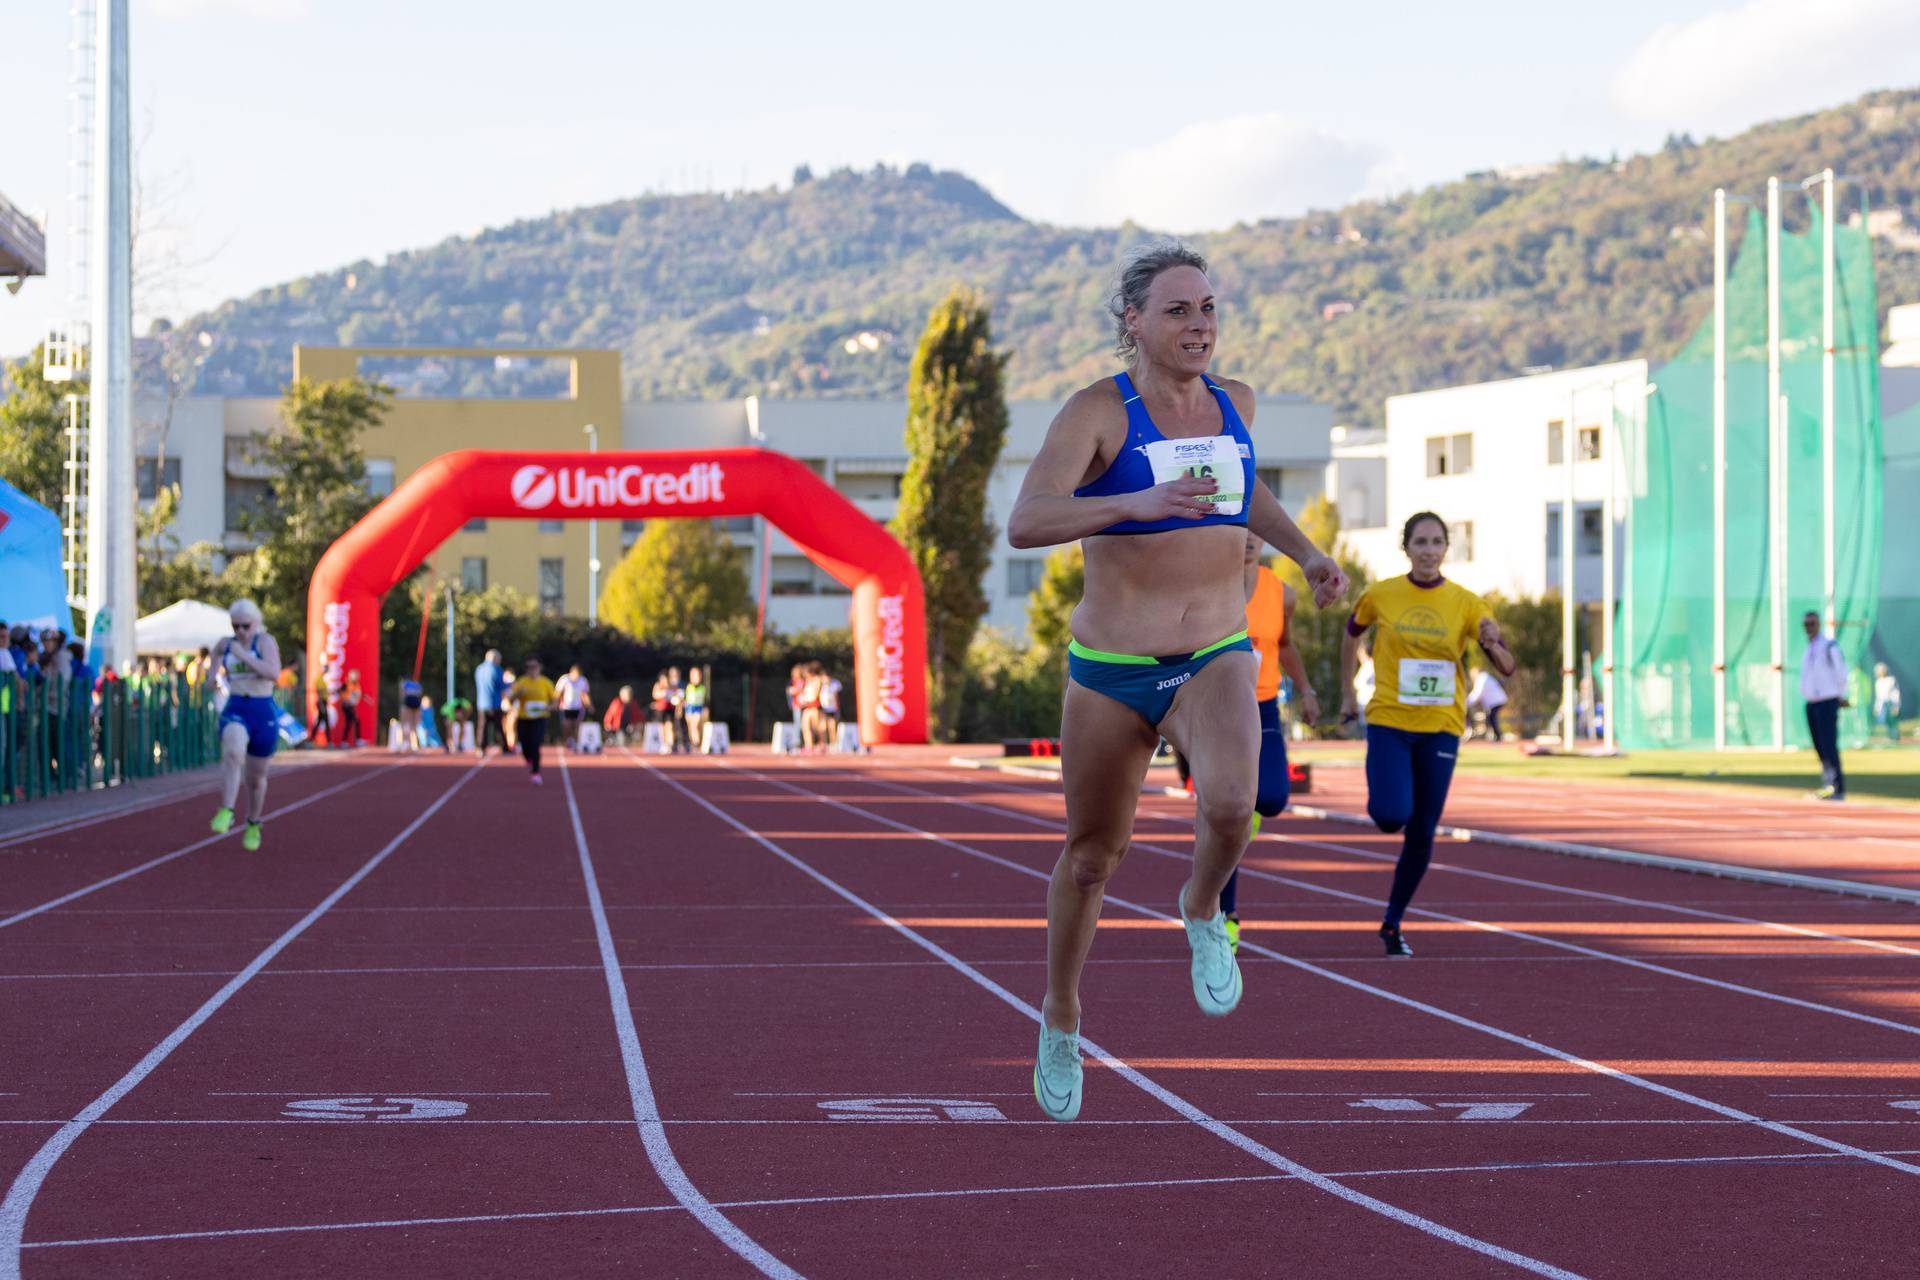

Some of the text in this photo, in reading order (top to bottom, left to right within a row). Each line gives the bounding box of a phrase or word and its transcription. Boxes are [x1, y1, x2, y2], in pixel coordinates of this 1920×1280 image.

[558, 462, 725, 508] UniCredit
[878, 595, 904, 697] UniCredit
[1157, 672, 1191, 690] Joma
[1419, 676, 1438, 692] 67
